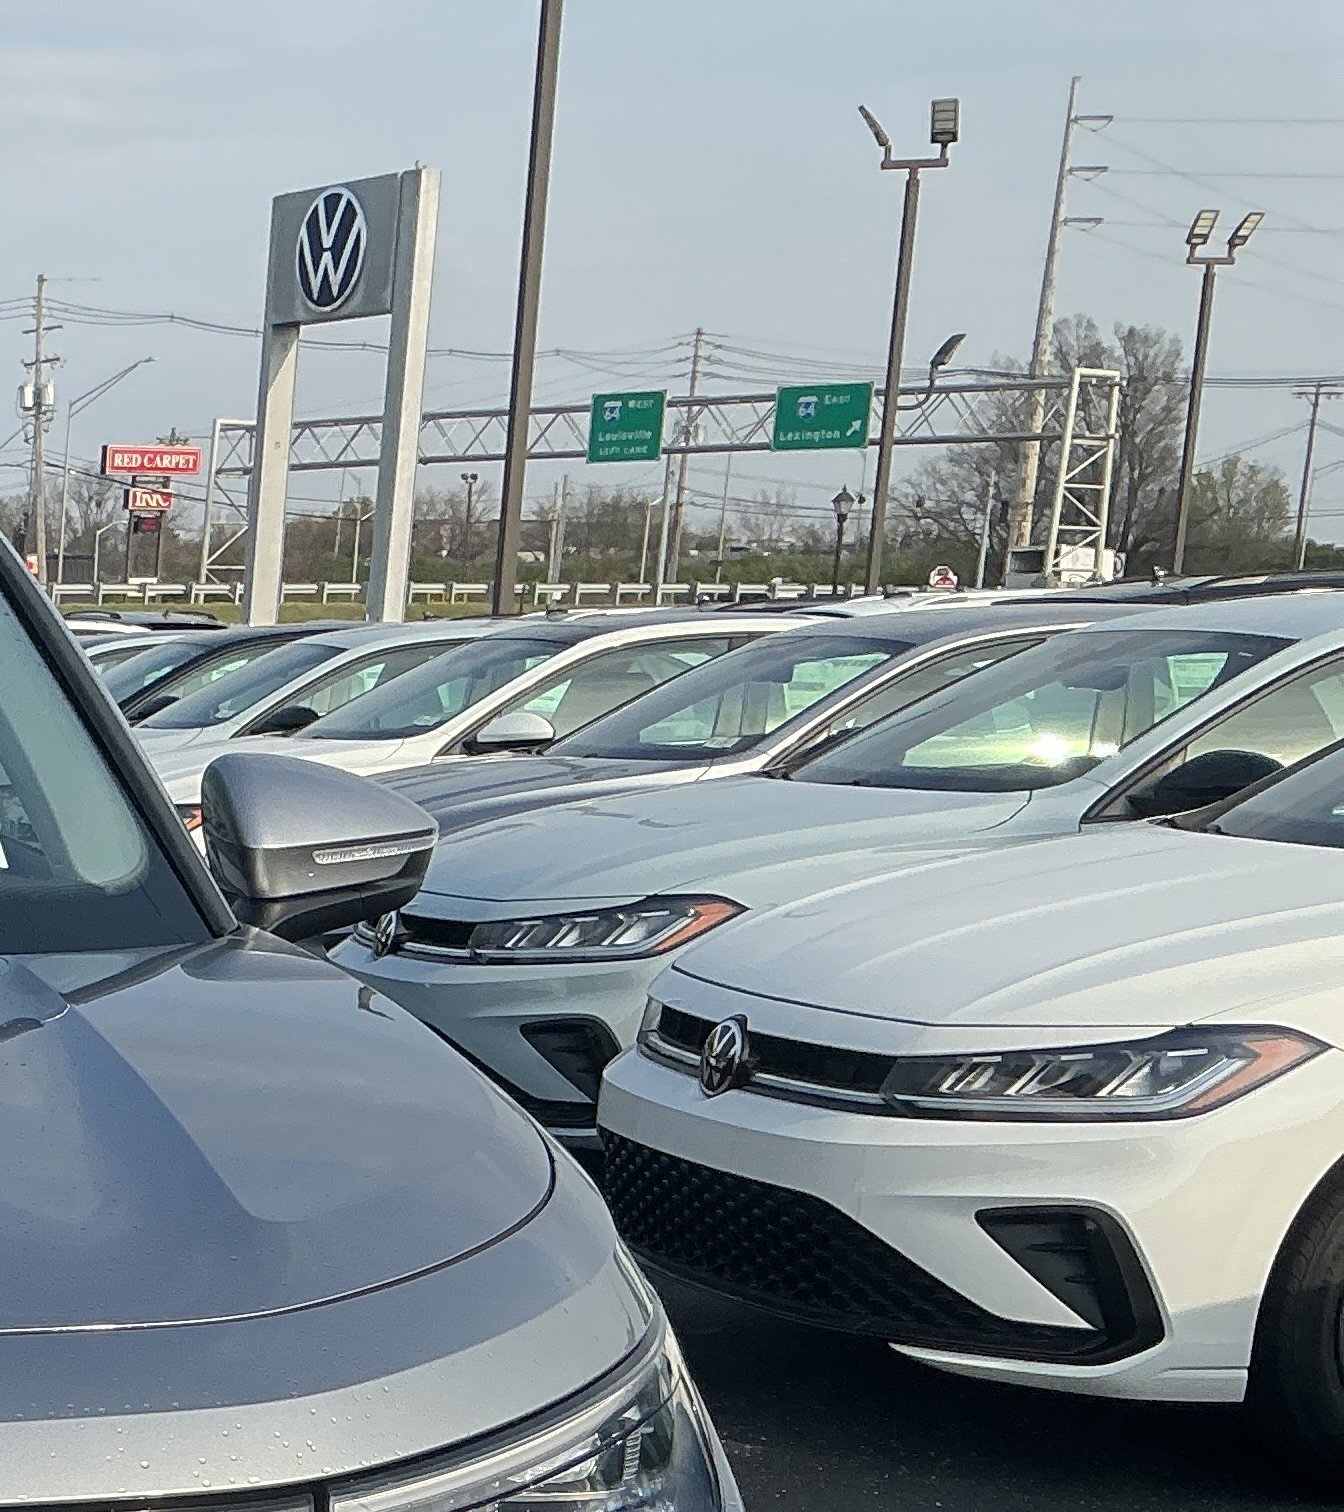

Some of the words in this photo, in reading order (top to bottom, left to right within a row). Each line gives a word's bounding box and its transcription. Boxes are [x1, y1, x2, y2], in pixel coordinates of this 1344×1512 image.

[779, 430, 841, 442] Lexington
[113, 453, 142, 468] RED
[143, 453, 197, 469] CARPET
